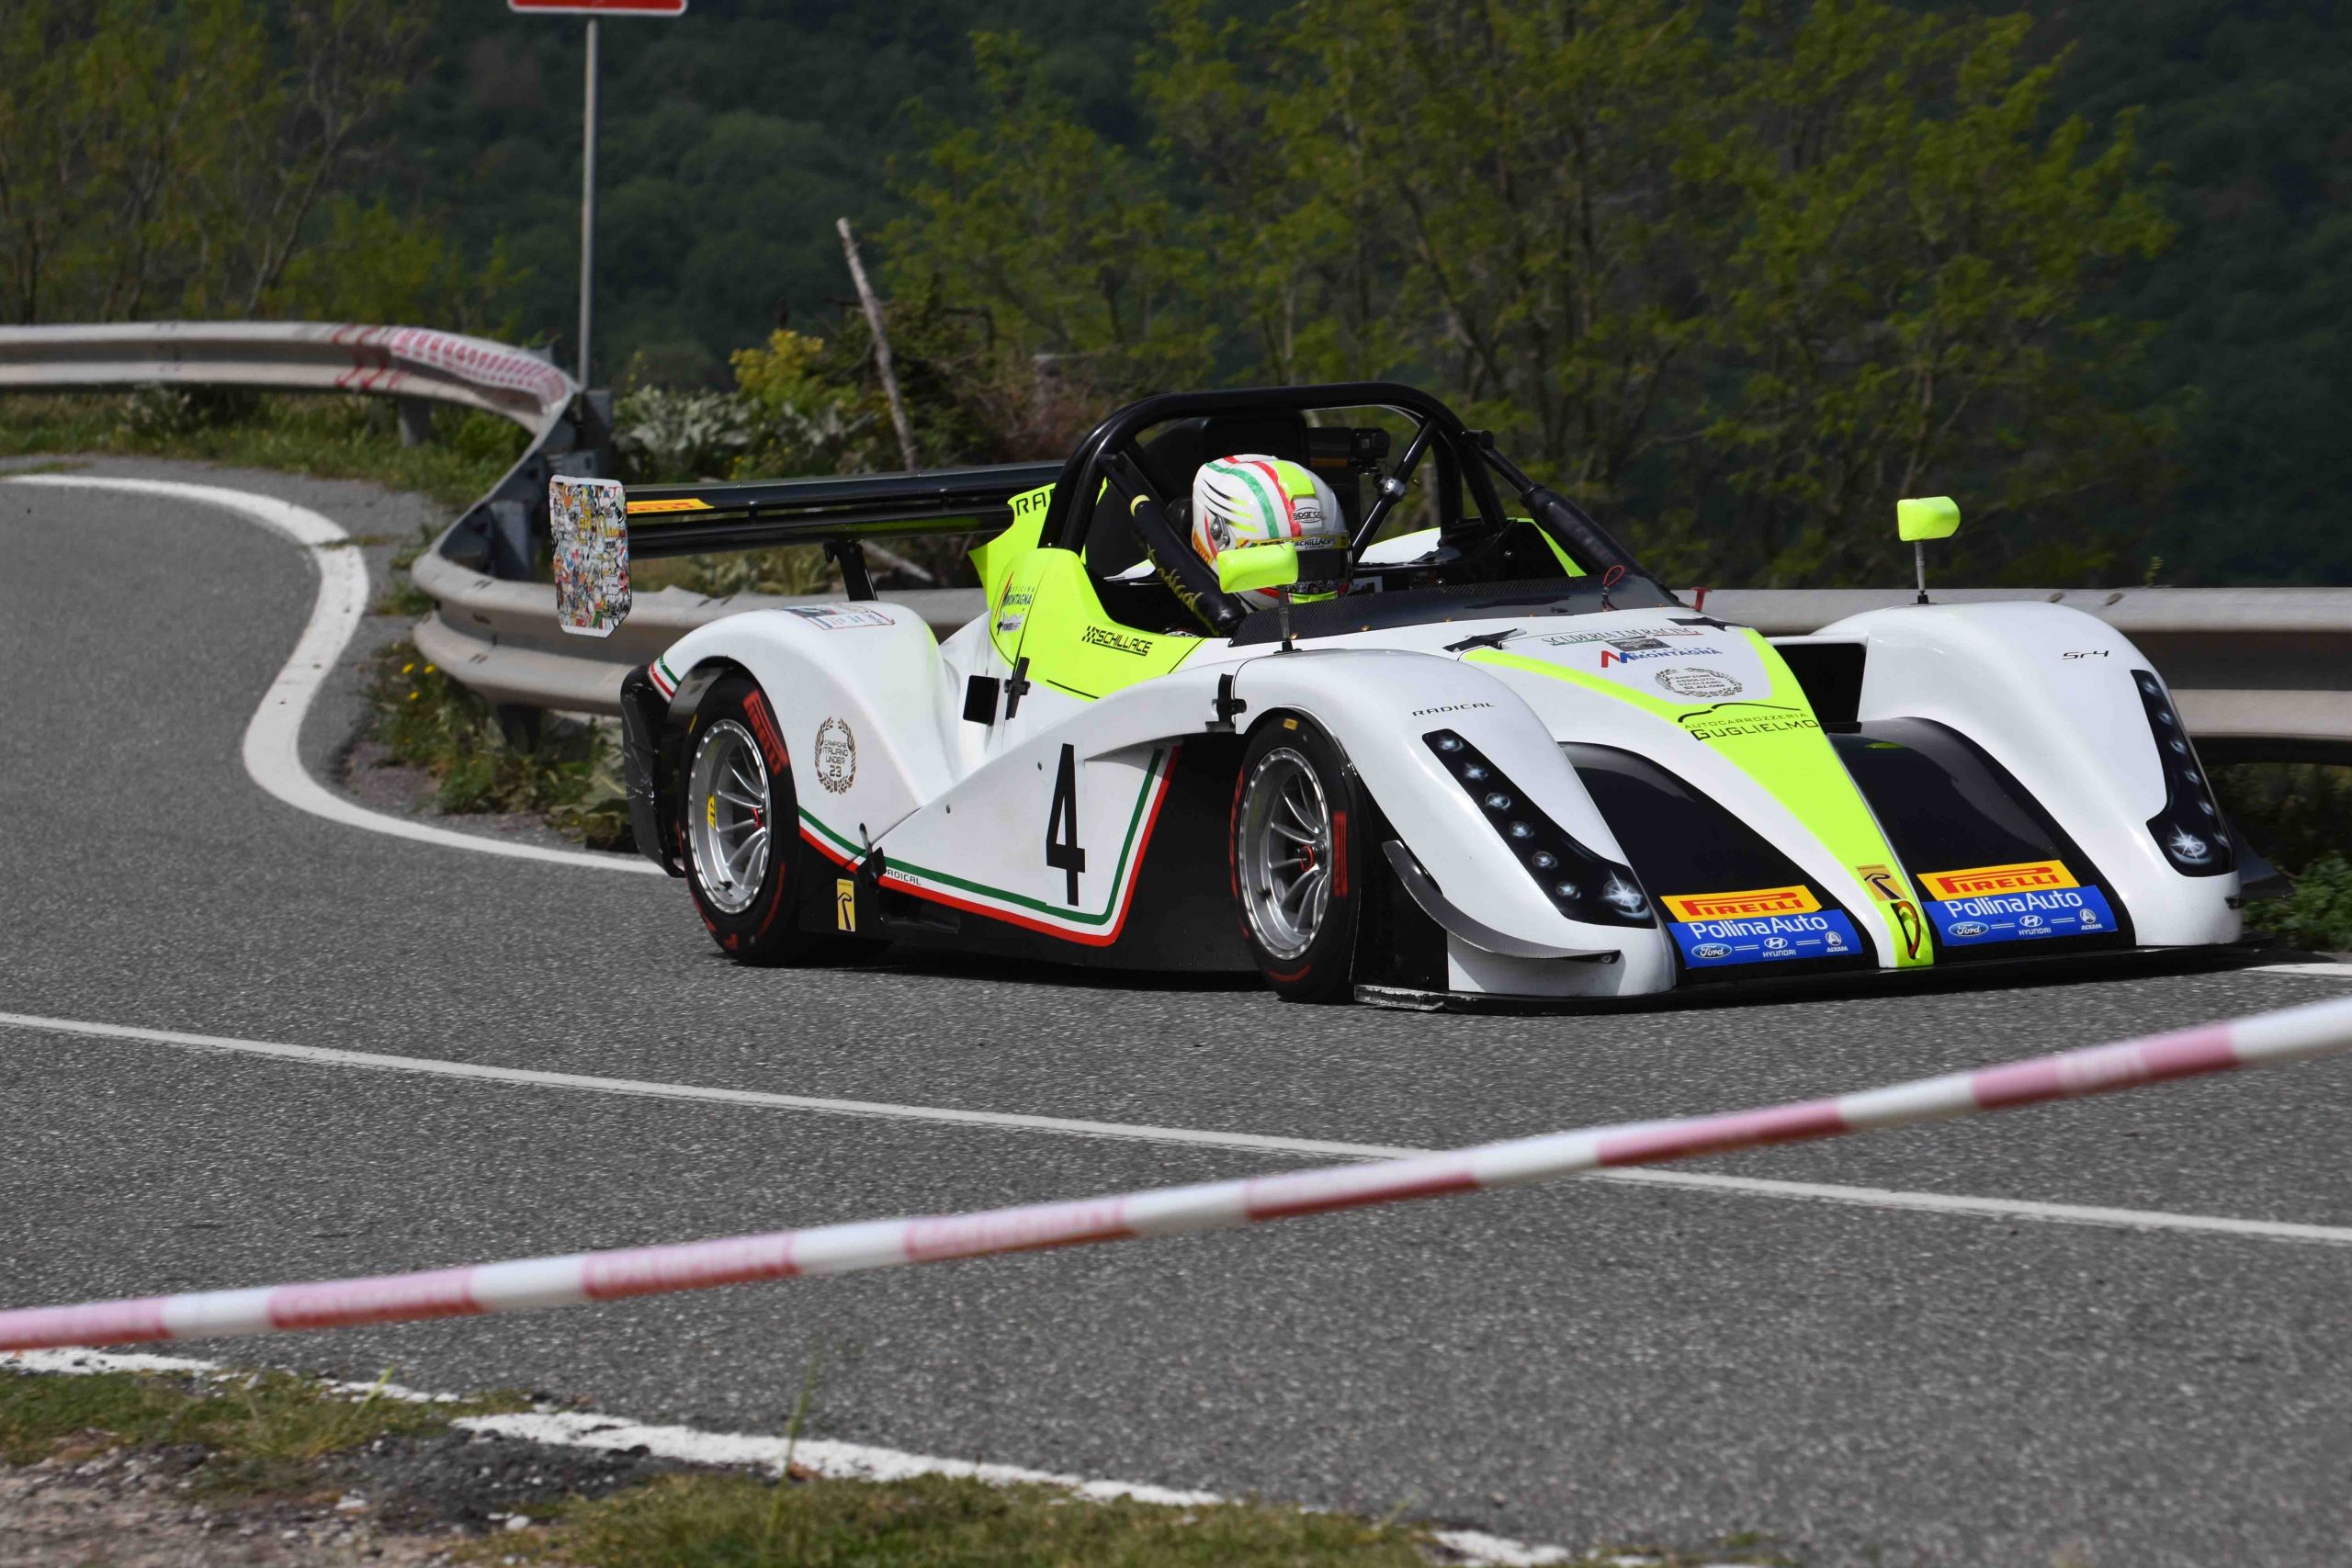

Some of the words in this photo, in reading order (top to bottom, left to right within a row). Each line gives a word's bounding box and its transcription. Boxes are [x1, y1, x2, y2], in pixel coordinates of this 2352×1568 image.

[1093, 630, 1153, 654] SCHILLACE
[1412, 703, 1497, 716] RADICAL
[1685, 713, 1809, 729] AUTOCARROZZERIA
[1690, 719, 1820, 741] GUGLIELMO
[829, 765, 842, 778] 23
[1046, 743, 1086, 907] 4
[886, 868, 922, 886] ADICAL
[1936, 866, 2061, 895] PIRELLI
[1679, 892, 1804, 917] PIRELLI
[1956, 922, 1982, 935] Ford
[2018, 927, 2052, 936] HYUNDAI
[1700, 944, 1725, 957] Ford
[1763, 949, 1797, 958] HYUNDAI
